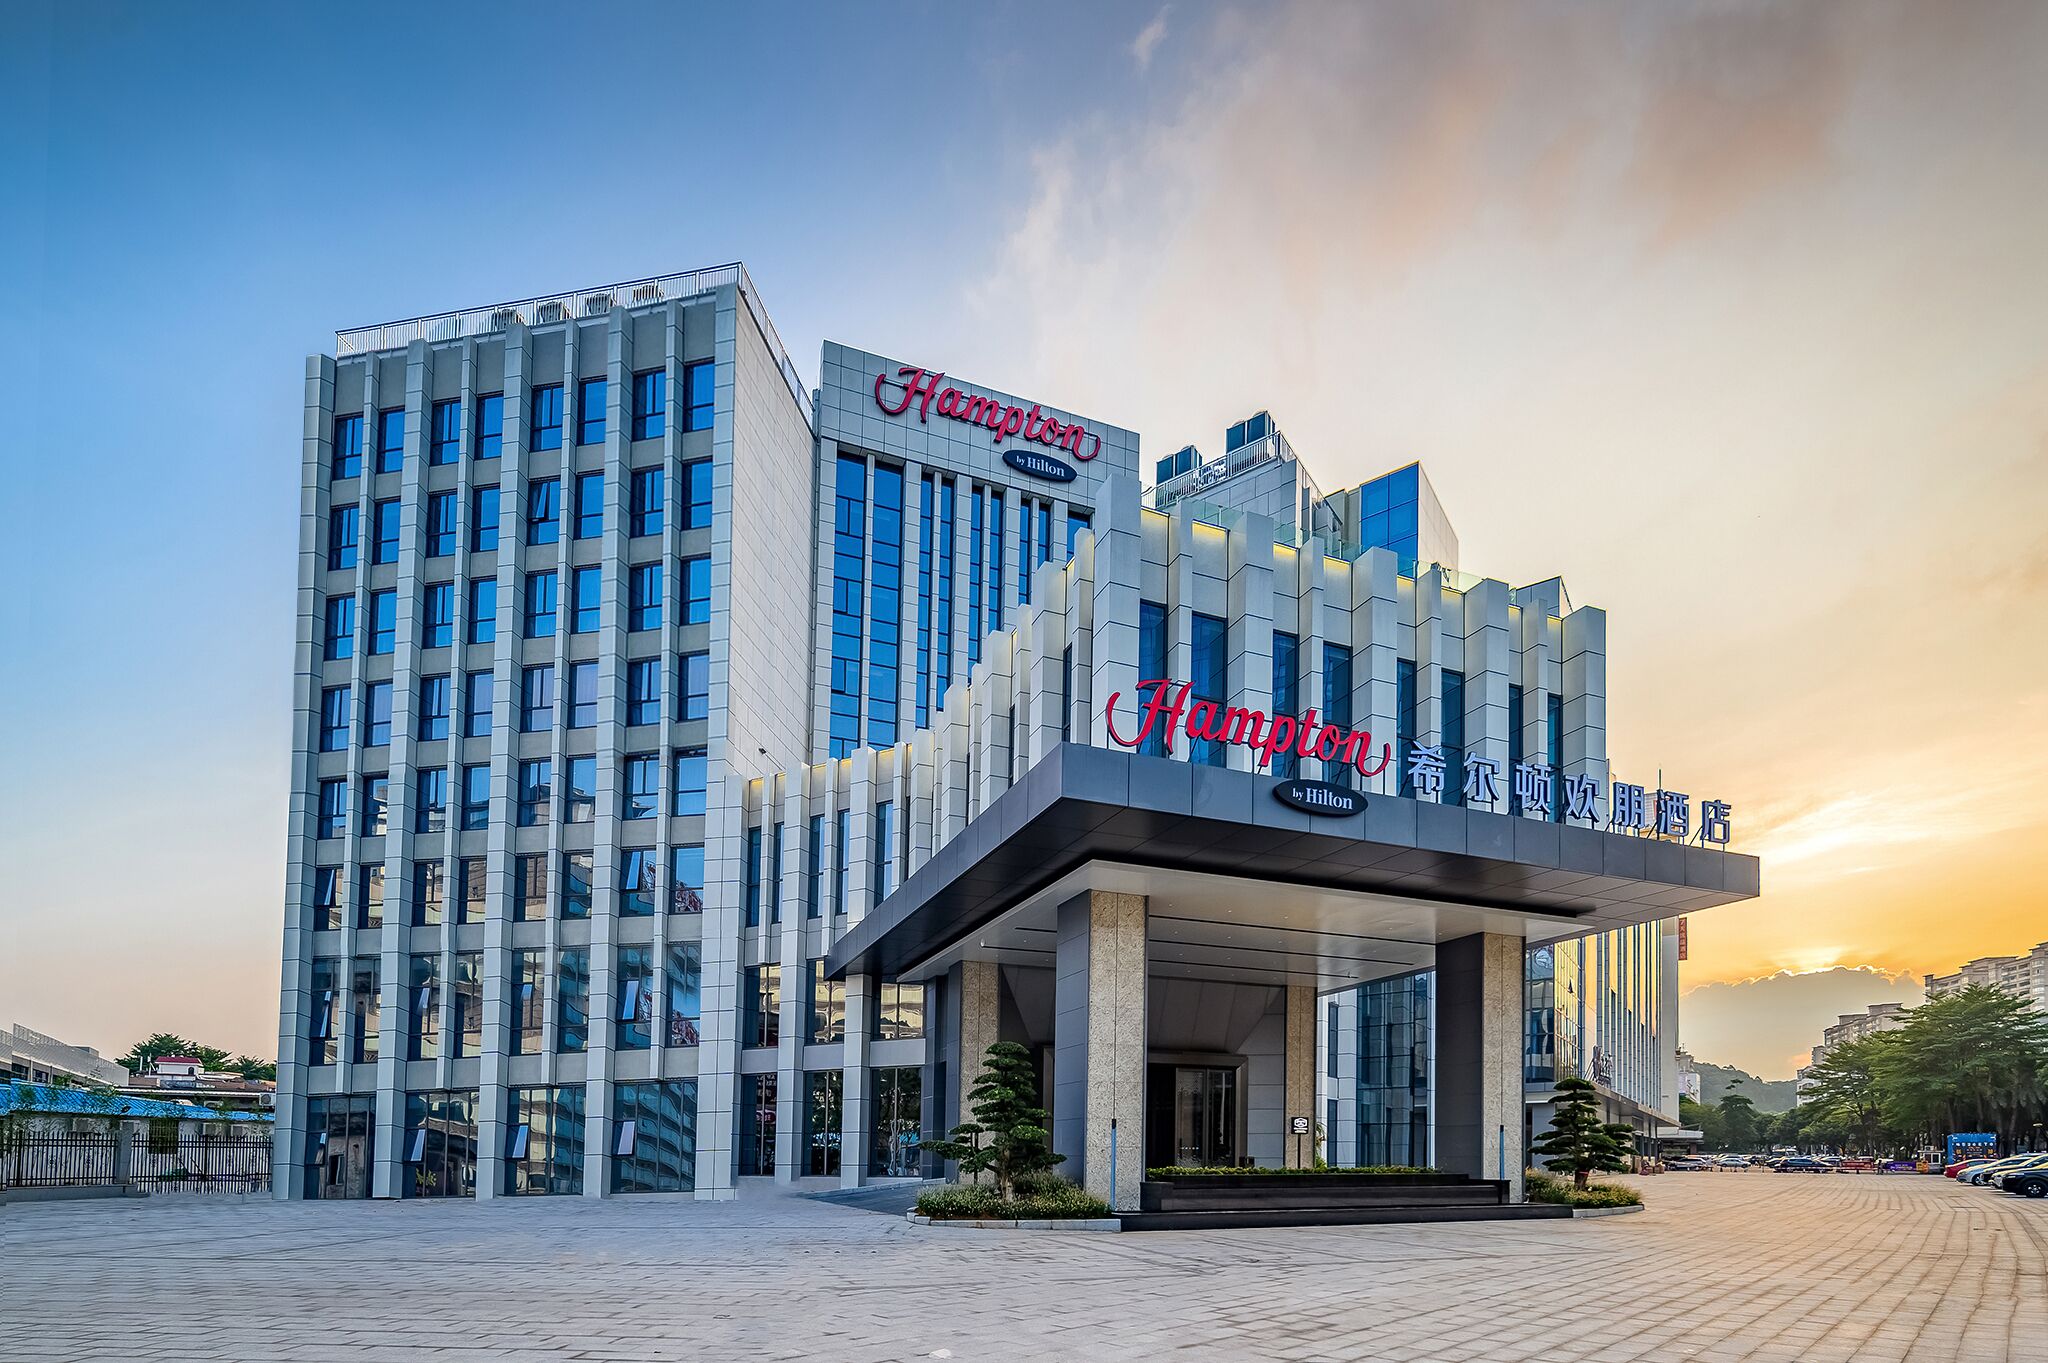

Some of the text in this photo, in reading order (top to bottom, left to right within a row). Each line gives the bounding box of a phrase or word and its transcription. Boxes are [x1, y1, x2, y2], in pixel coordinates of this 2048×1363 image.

[875, 368, 1101, 461] Hampton
[1016, 455, 1065, 477] by Hilton
[1106, 678, 1391, 776] Hampton
[1292, 787, 1353, 810] by Hilton
[1407, 740, 1732, 844] 希尔顿欢朋酒店
